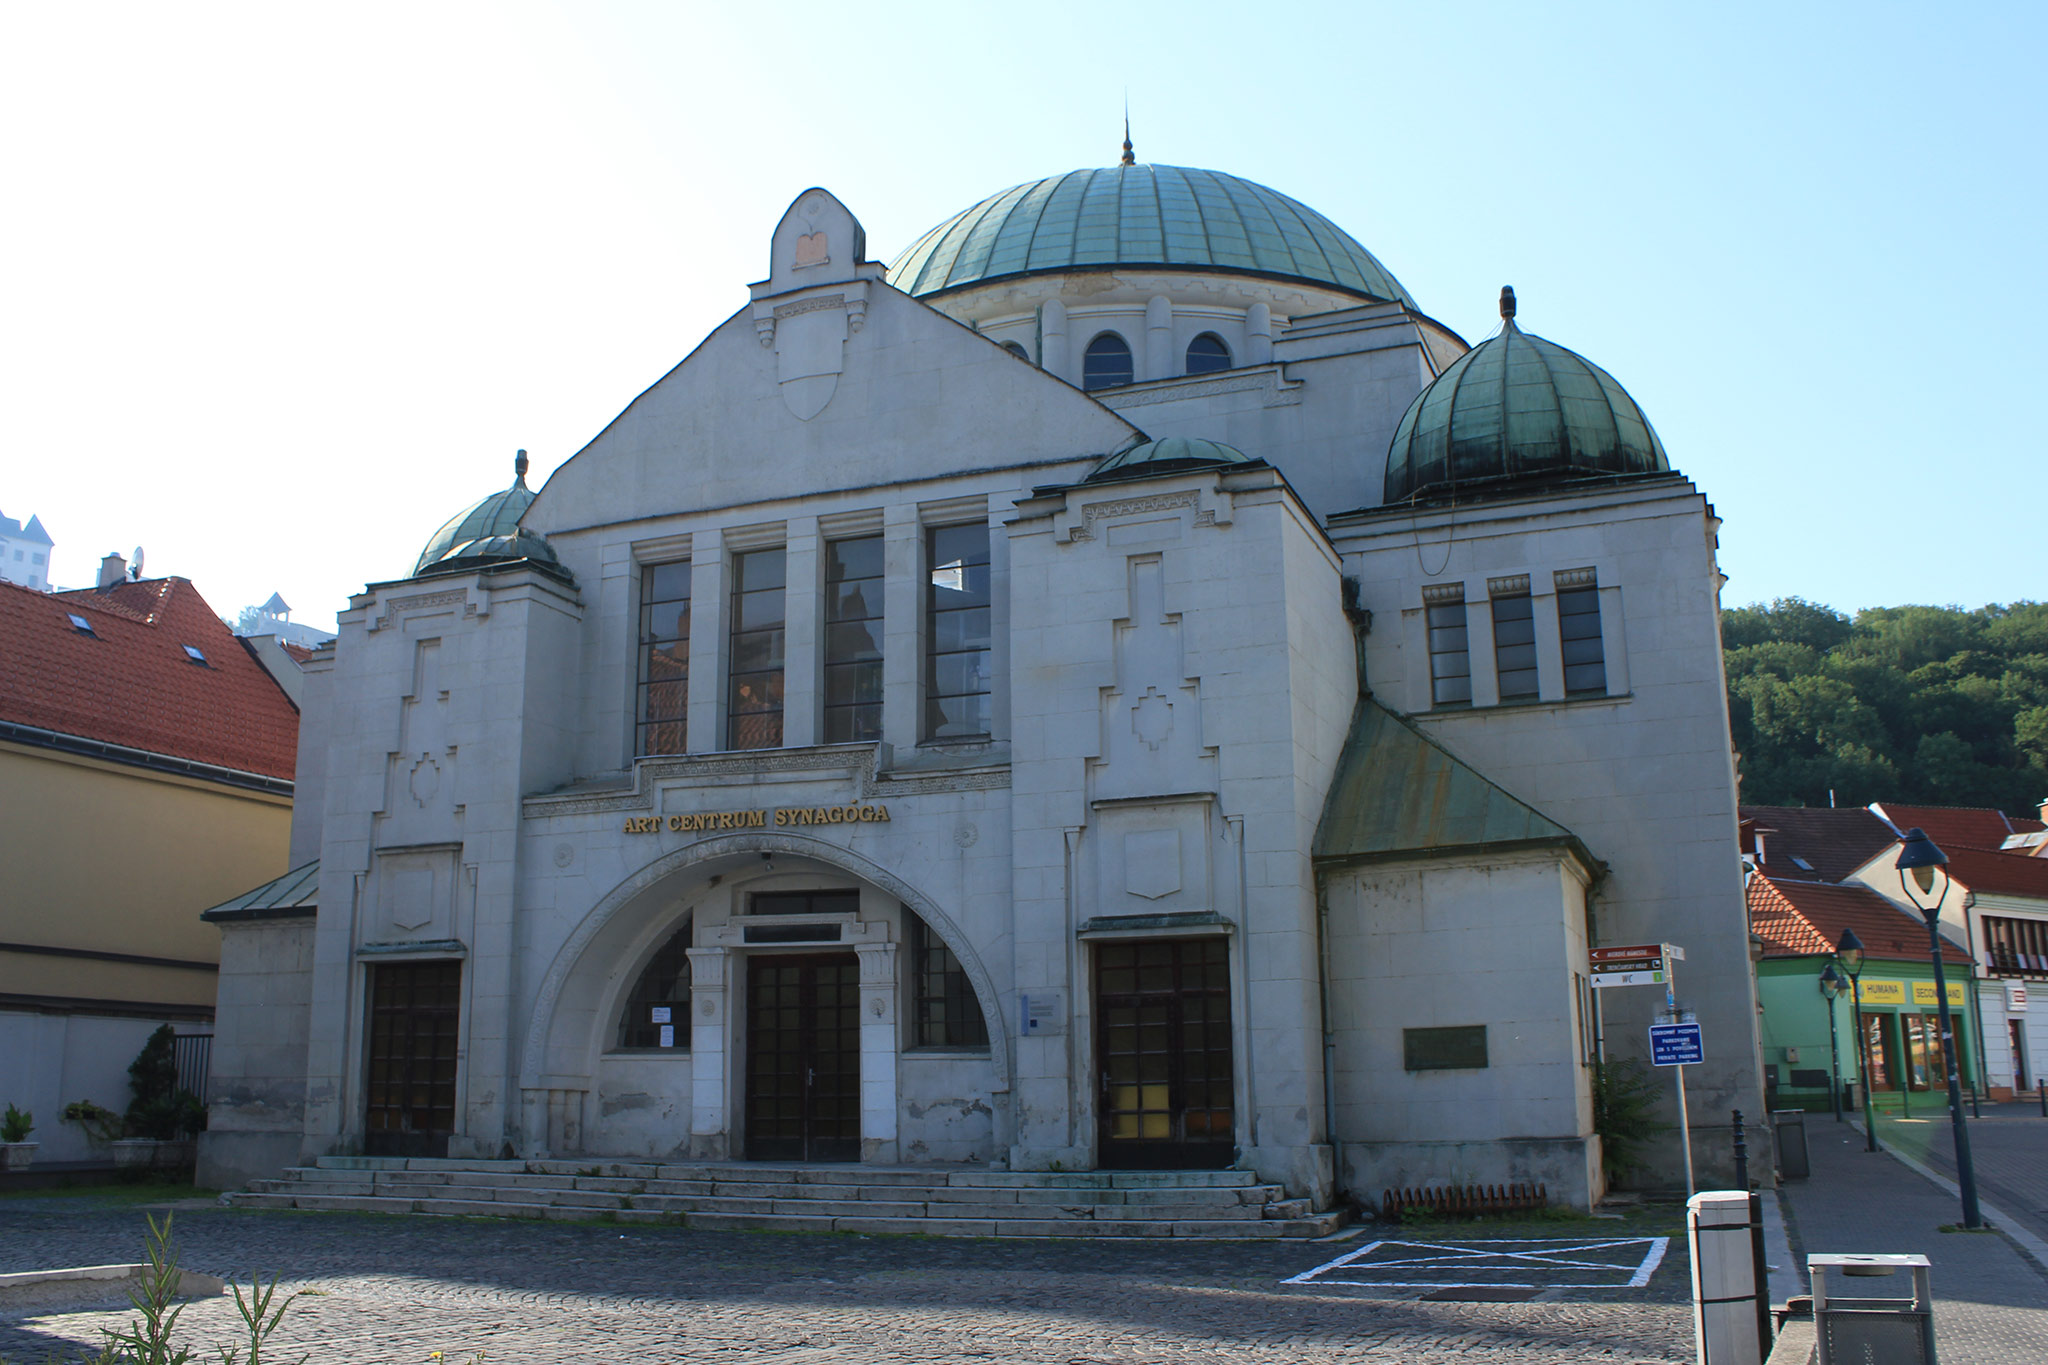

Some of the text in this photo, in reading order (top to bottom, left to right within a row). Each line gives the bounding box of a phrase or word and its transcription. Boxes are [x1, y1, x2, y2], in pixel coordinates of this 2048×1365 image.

[622, 800, 891, 833] ART CENTRUM SYNAGÓGA
[1621, 975, 1633, 983] WC
[1866, 984, 1898, 993] HUMANA
